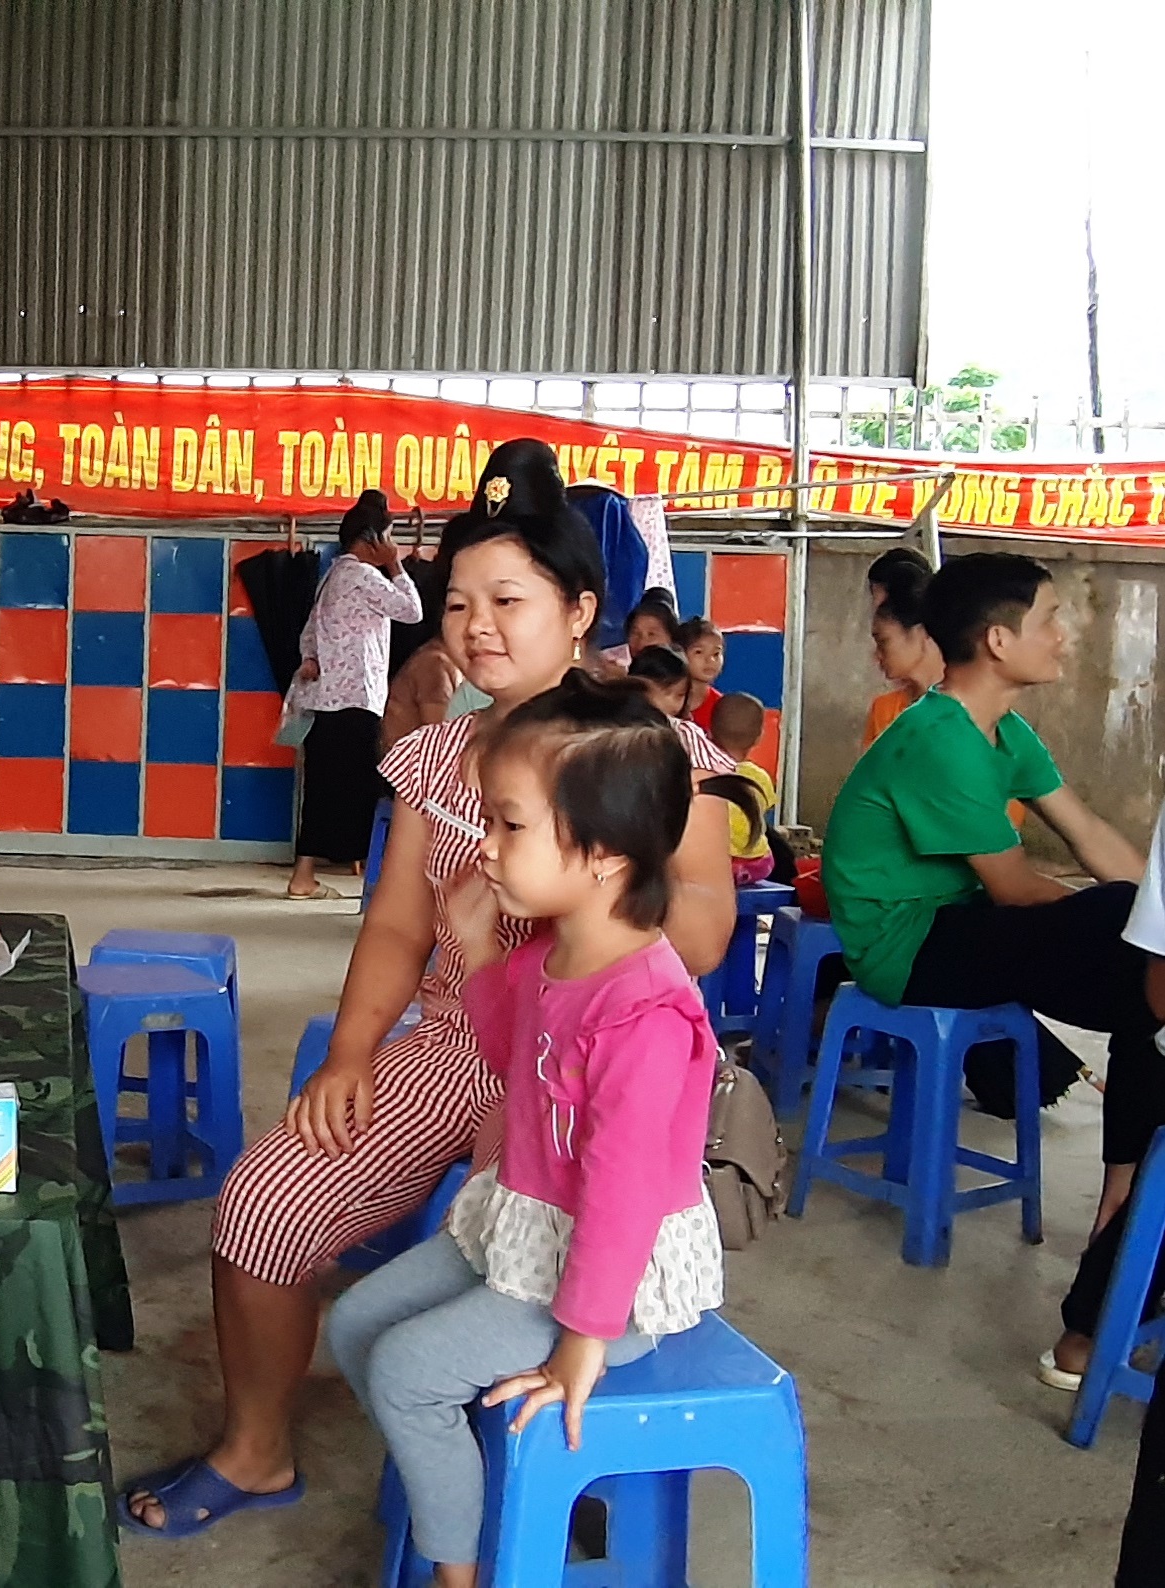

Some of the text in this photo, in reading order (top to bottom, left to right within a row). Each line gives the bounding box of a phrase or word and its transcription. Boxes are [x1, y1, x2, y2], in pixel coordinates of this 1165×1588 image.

[58, 411, 161, 491] TOÀN
[171, 413, 265, 504] DÂN,
[277, 416, 383, 498] TOÀN
